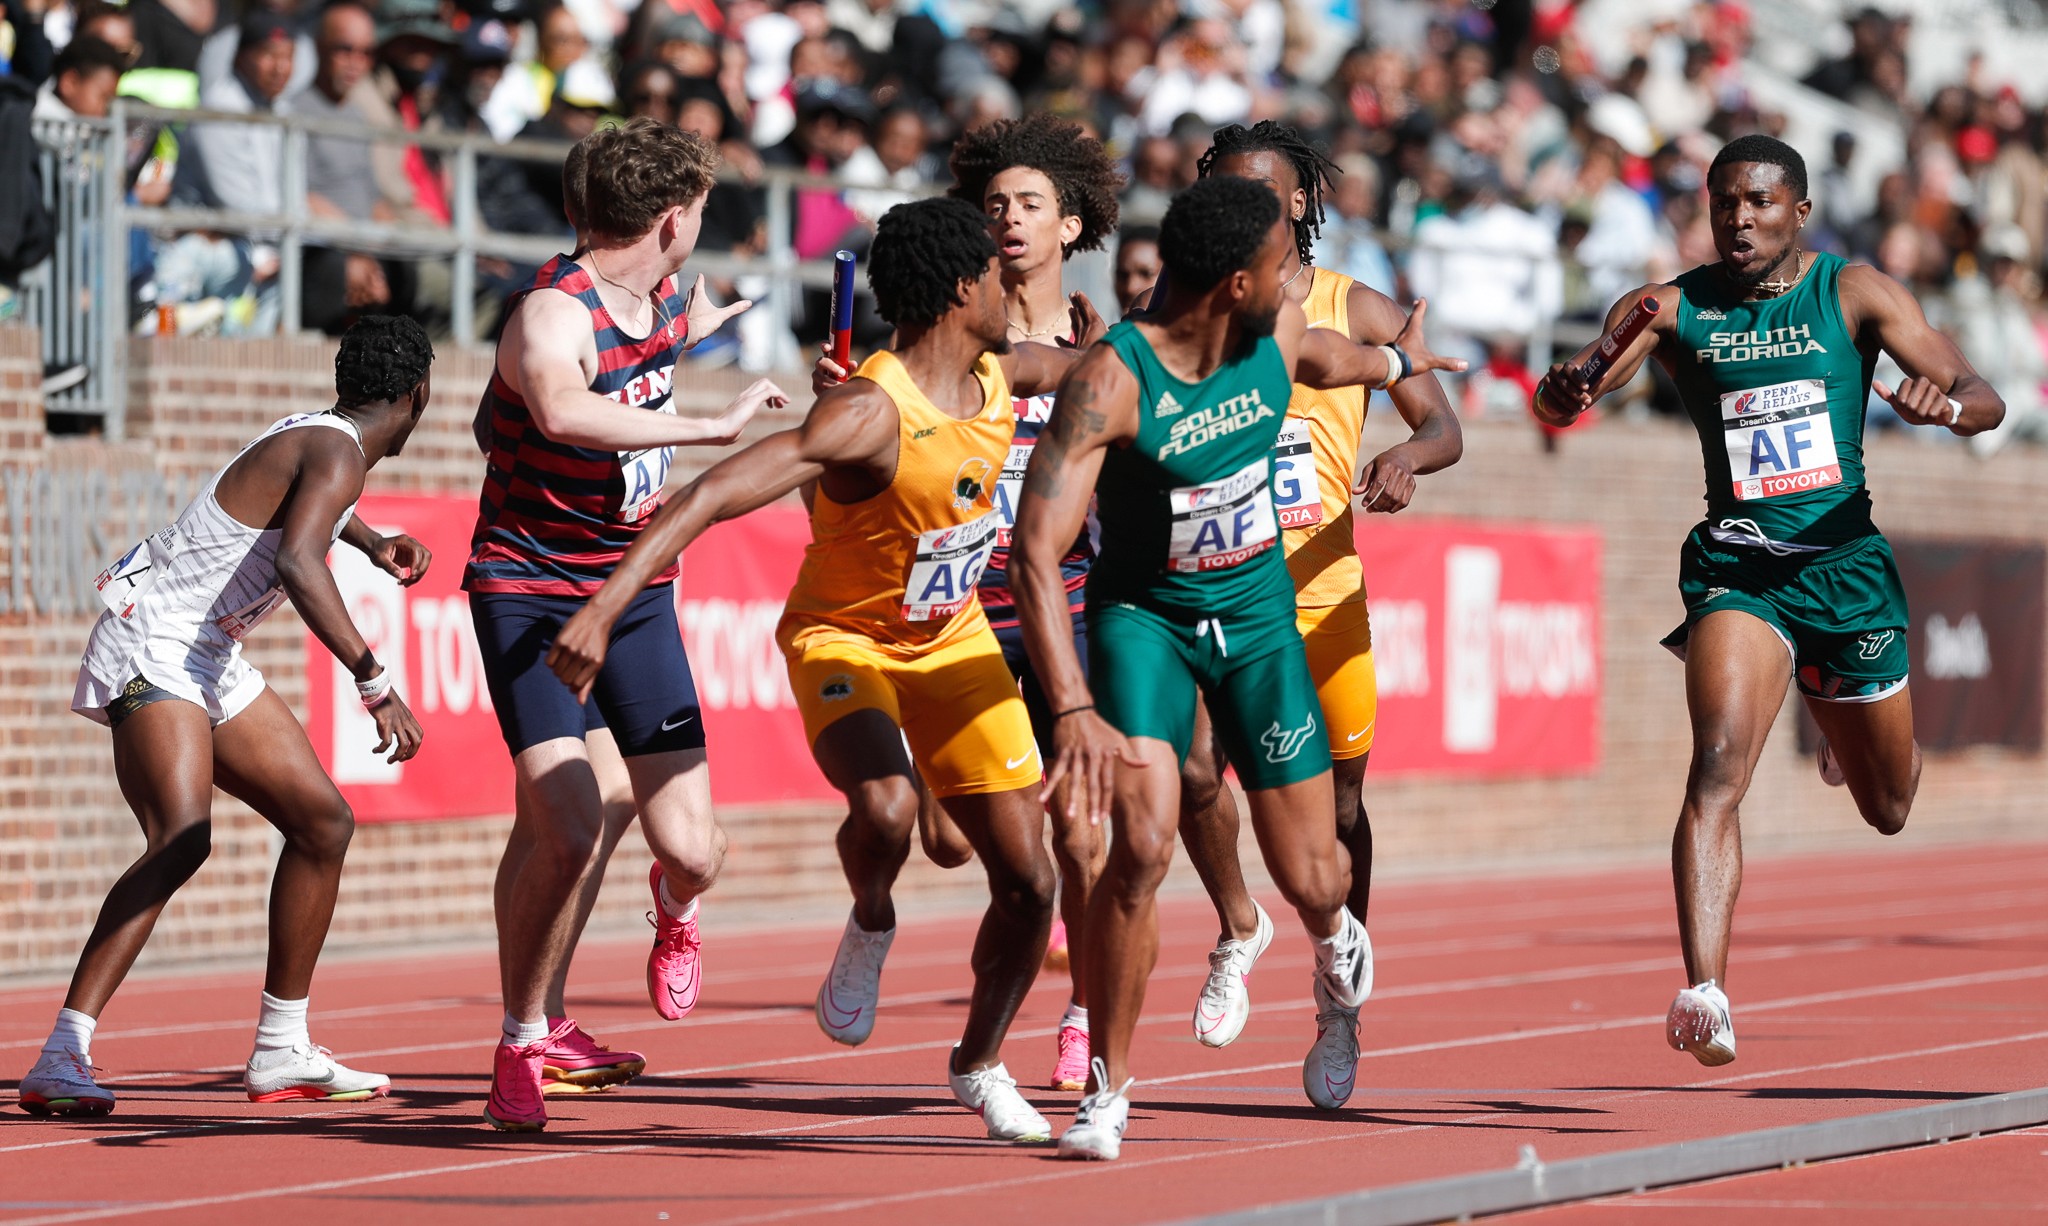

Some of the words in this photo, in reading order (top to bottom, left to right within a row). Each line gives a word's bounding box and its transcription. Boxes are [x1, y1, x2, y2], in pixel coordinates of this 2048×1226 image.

[1613, 308, 1641, 339] TOYOTA
[1696, 312, 1727, 321] adidas
[1709, 323, 1811, 348] SOUTH
[1696, 339, 1828, 363] FLORIDA
[1763, 385, 1799, 400] PENN
[1763, 392, 1811, 409] RELAYS
[1170, 388, 1261, 441] SOUTH
[1740, 417, 1765, 427] Dream
[1158, 404, 1276, 462] FLORIDA
[1749, 420, 1813, 476] AF
[1765, 470, 1831, 493] TOYOTA
[1187, 502, 1256, 555] AF
[1203, 543, 1266, 568] TOYOTA
[918, 550, 984, 602] AG
